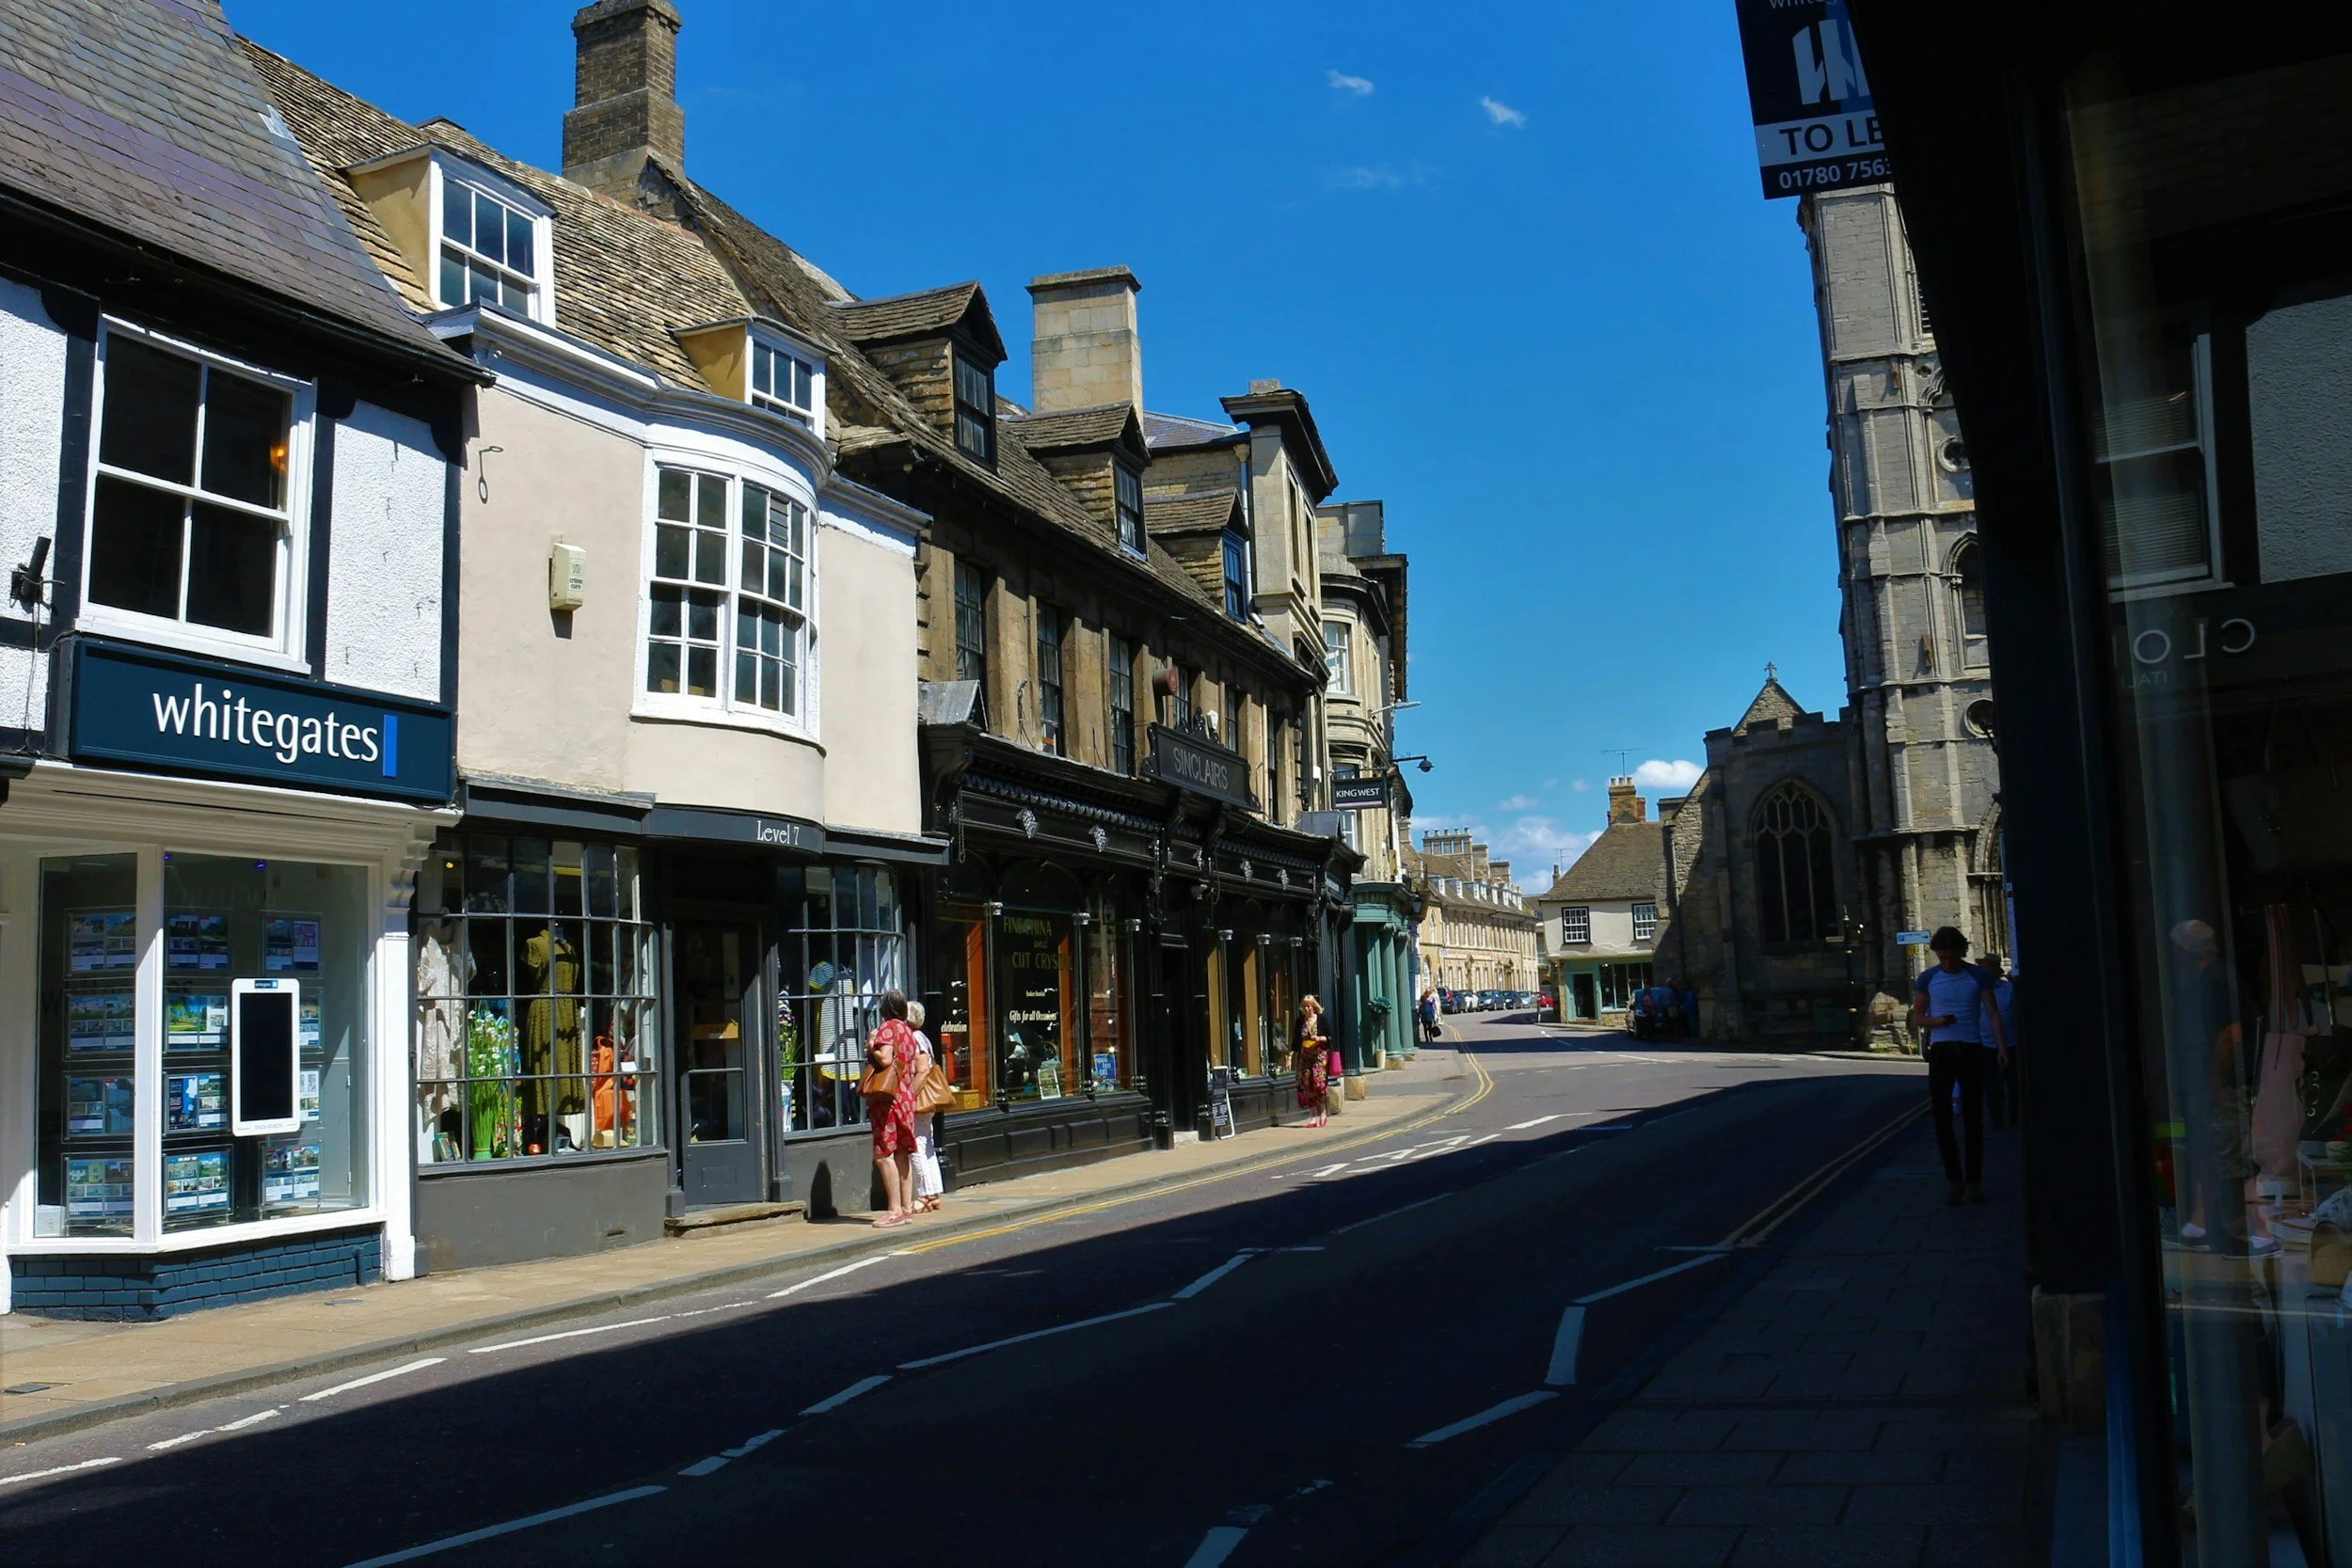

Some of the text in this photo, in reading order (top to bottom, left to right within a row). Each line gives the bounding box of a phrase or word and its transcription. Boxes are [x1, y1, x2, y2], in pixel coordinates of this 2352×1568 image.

[1779, 123, 1834, 156] TO
[1779, 165, 1841, 189] 01780
[152, 683, 379, 764] whitegates
[1173, 747, 1229, 790] SINCLAIRS
[1336, 787, 1380, 799] KING WEST
[756, 819, 800, 846] Level 7
[1003, 915, 1023, 934] FINE
[1033, 936, 1049, 949] and
[1011, 952, 1073, 971] CUT CRYS
[1009, 1009, 1021, 1023] Gifts
